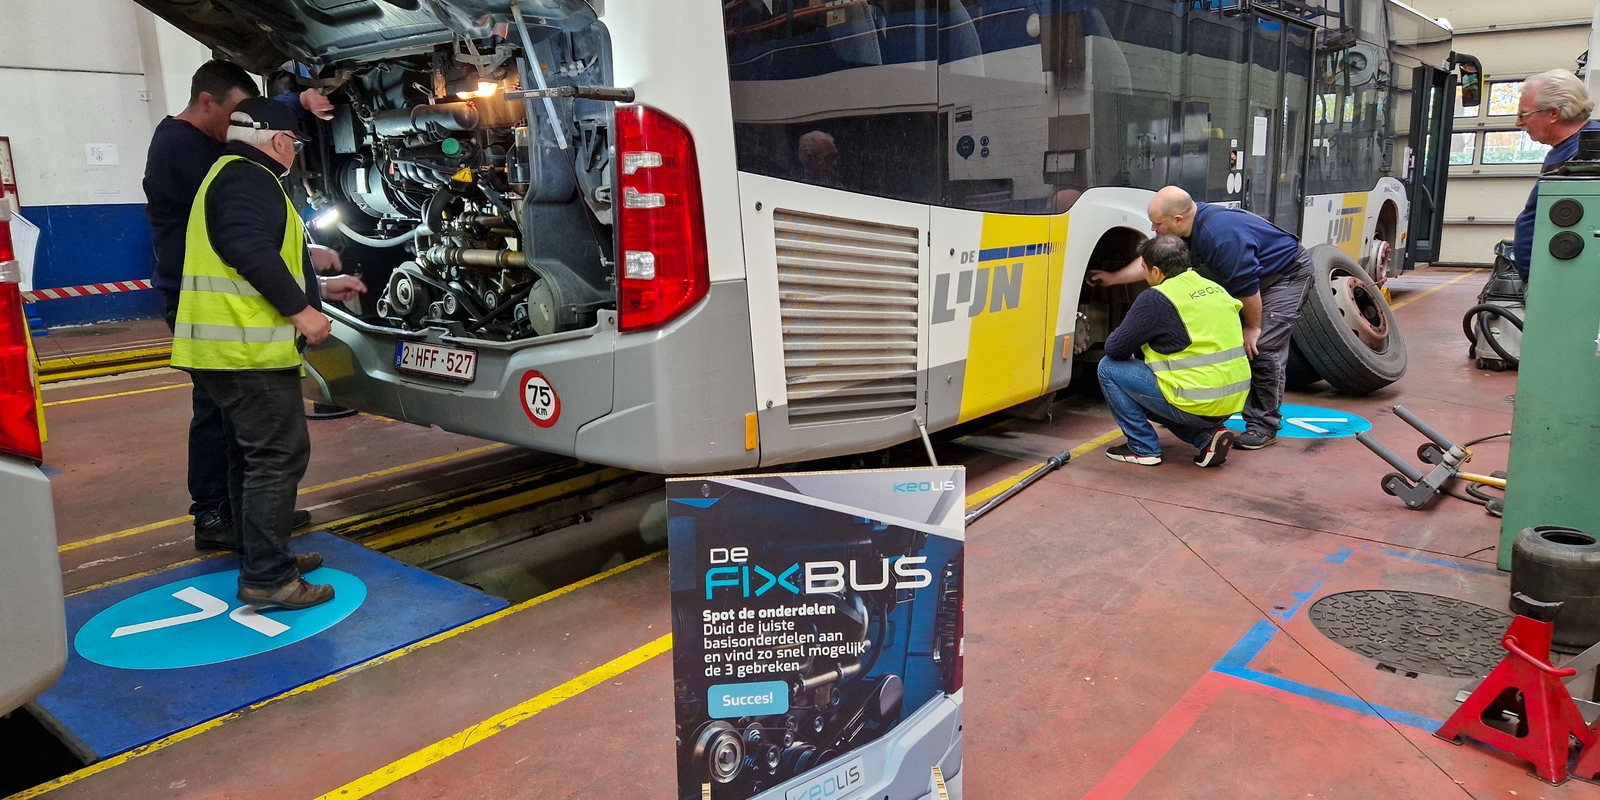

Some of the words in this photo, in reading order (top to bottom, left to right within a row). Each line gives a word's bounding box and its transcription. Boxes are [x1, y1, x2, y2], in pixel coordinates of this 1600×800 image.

[960, 250, 976, 264] DE
[931, 262, 1024, 325] LIJN
[528, 384, 551, 407] 75
[702, 609, 736, 624] Spot
[738, 607, 755, 619] de
[758, 603, 836, 619] onderdelen
[703, 622, 734, 636] Duid
[738, 620, 755, 633] de
[758, 619, 795, 635] juiste
[704, 632, 815, 650] basisonderdelen
[819, 632, 843, 642] aan
[704, 652, 721, 663] en
[724, 648, 754, 662] vind
[757, 649, 773, 660] zo
[776, 645, 805, 659] snel
[808, 641, 866, 659] mogelijk
[704, 665, 721, 677] de
[725, 664, 734, 676] 3
[737, 660, 800, 678] gebreken
[722, 691, 774, 707] Succes!
